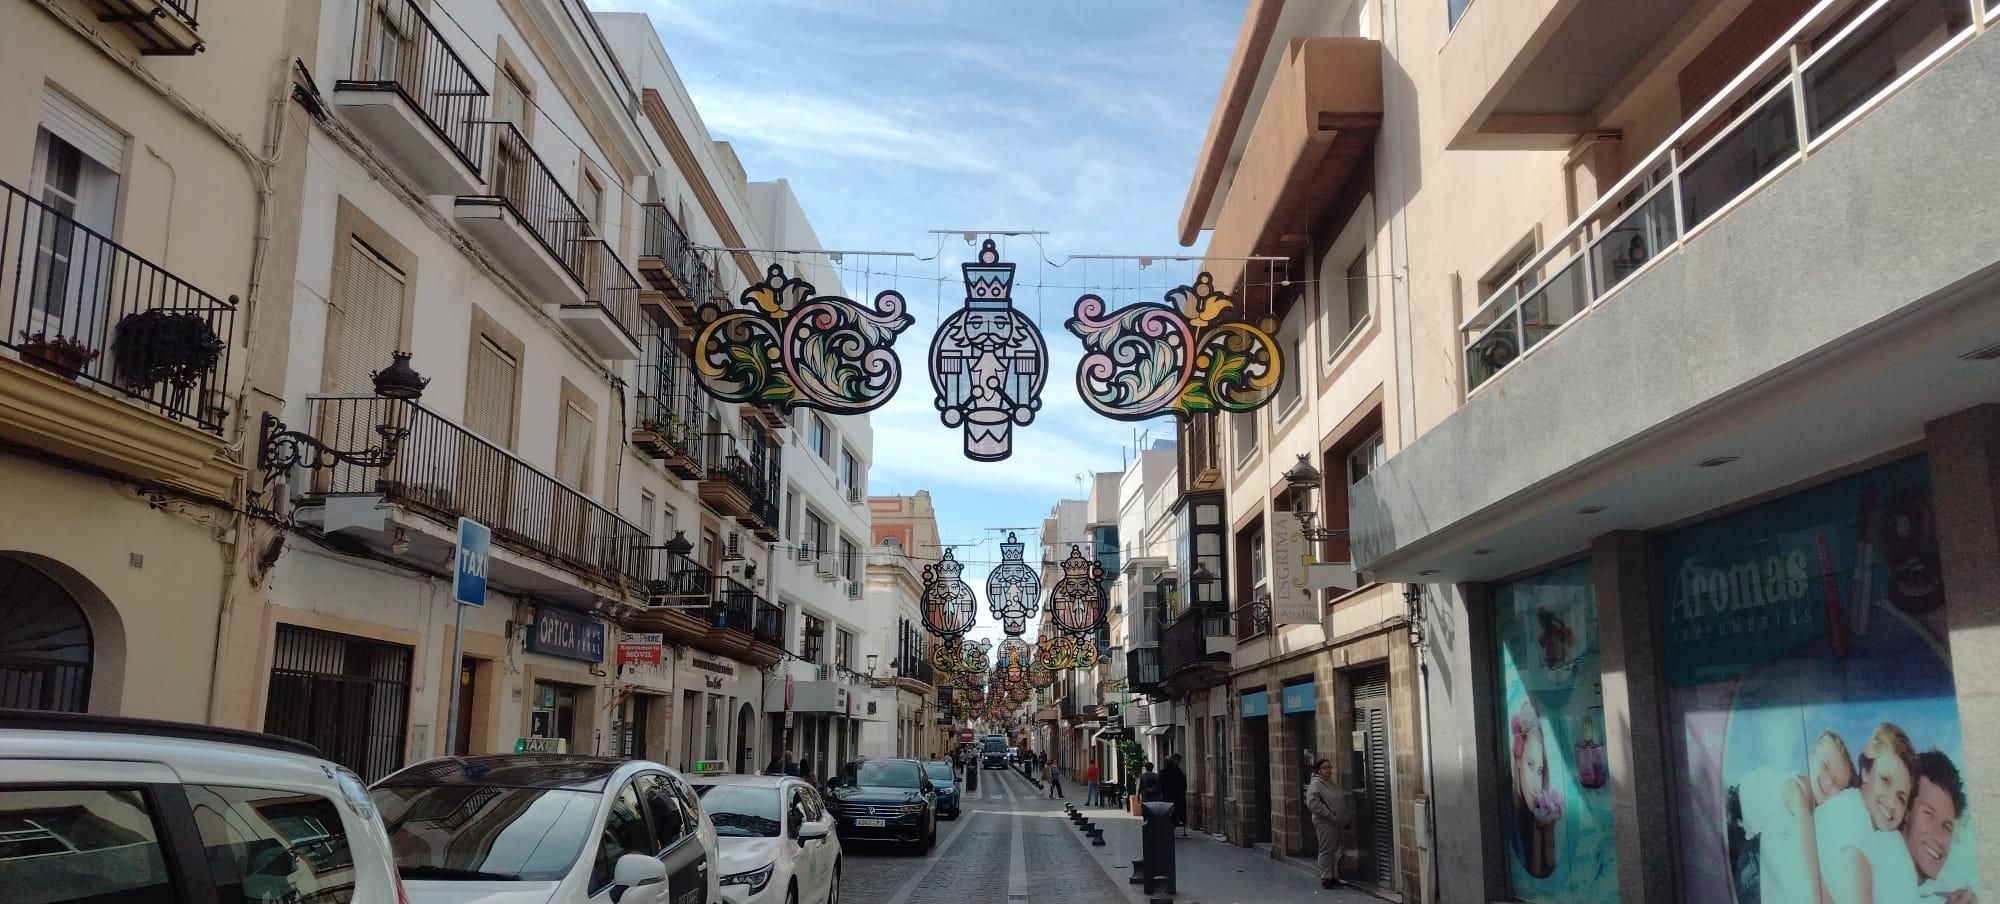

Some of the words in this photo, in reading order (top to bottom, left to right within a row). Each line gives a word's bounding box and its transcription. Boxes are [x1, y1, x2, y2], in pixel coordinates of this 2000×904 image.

[461, 547, 488, 579] TAXI
[1275, 518, 1290, 600] ESGRIMA
[1671, 549, 1809, 621] Aromas
[526, 739, 549, 751] TAXI
